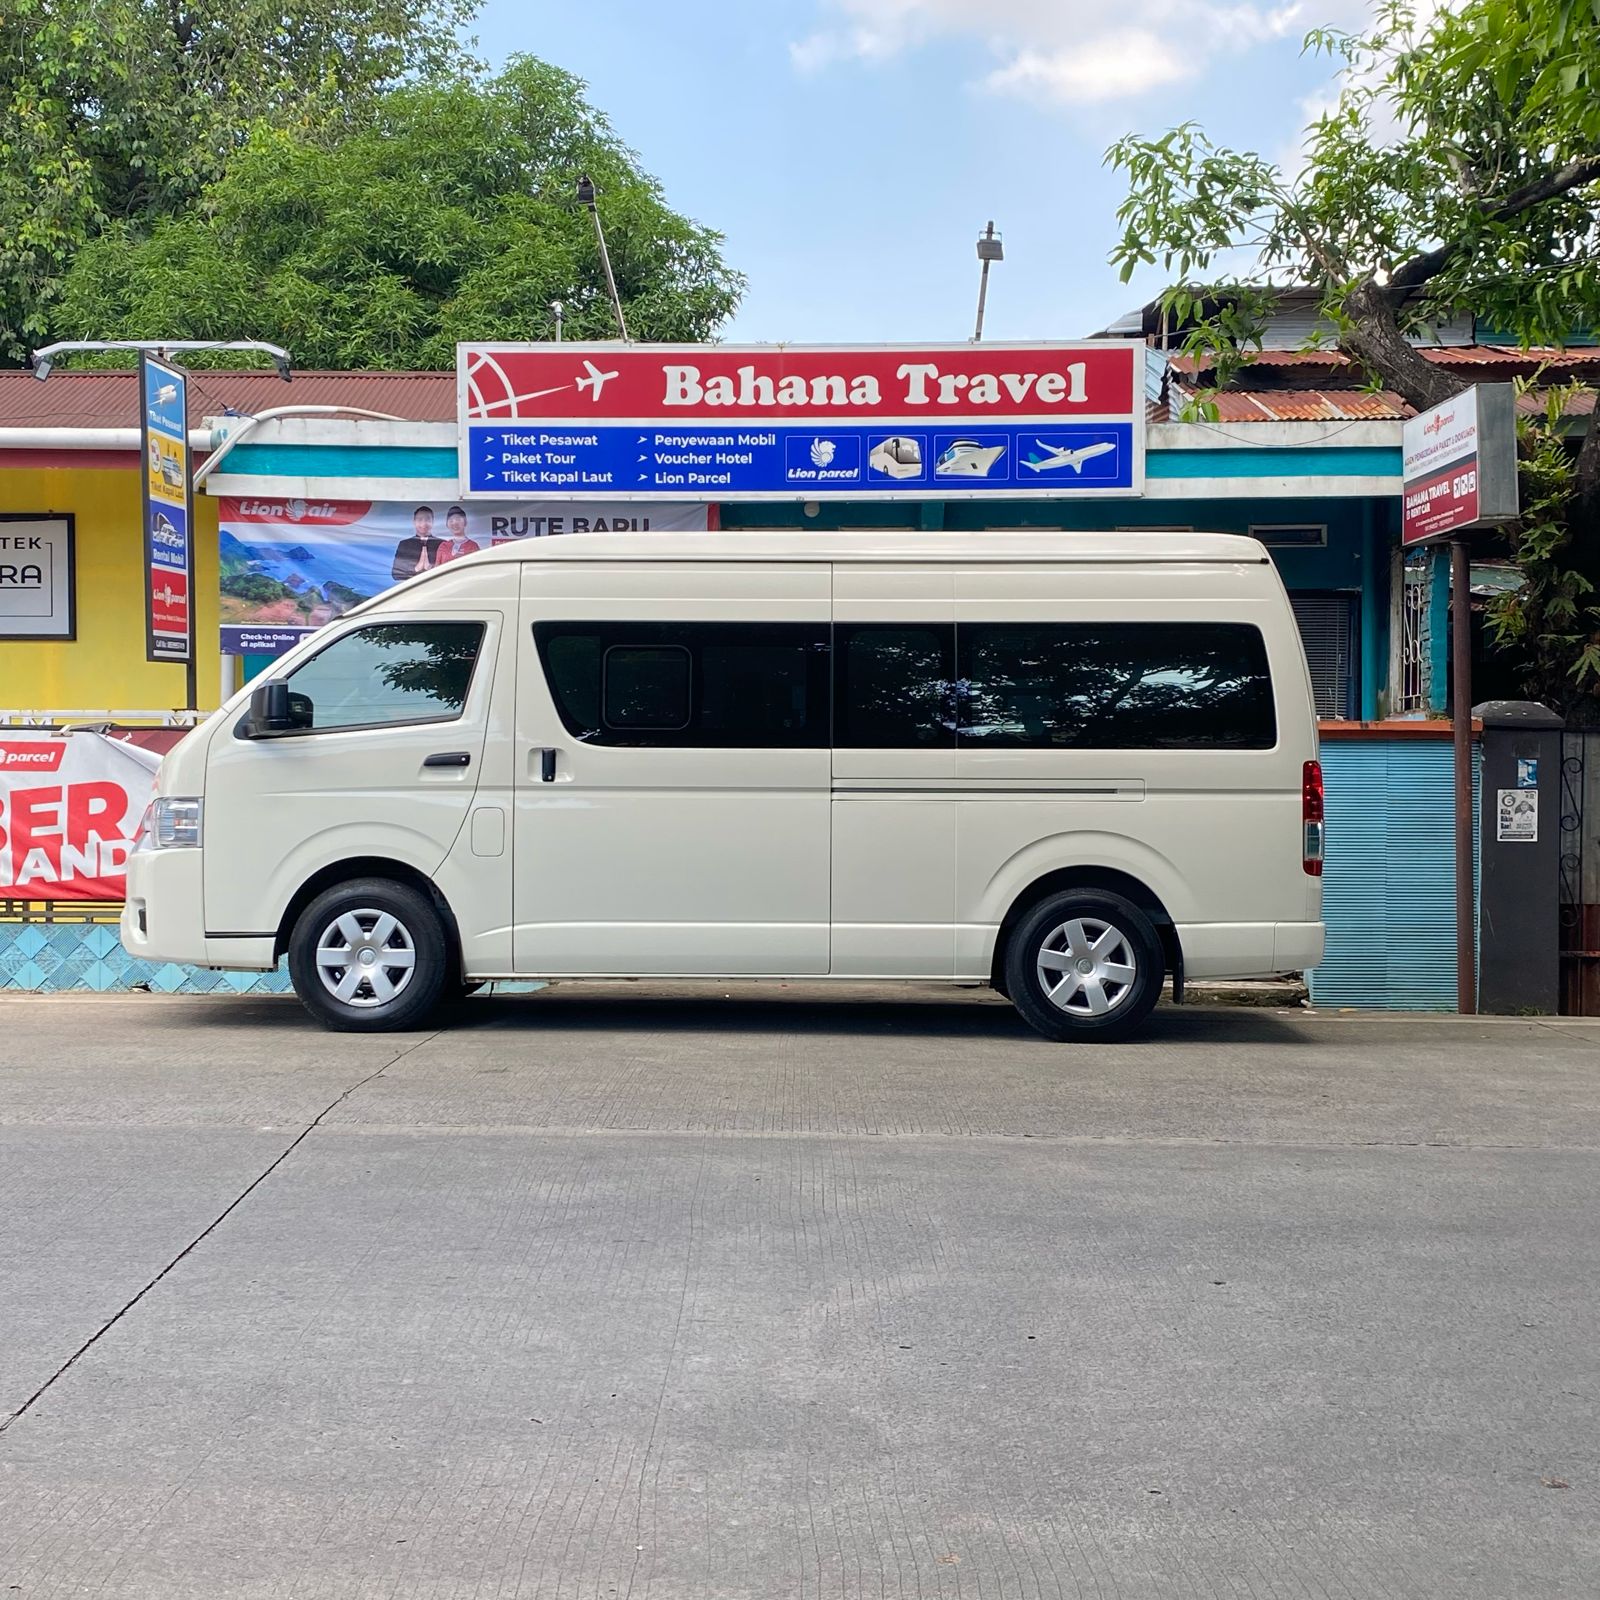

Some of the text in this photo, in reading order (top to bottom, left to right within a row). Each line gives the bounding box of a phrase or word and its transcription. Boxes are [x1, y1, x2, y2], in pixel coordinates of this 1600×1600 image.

[662, 362, 1089, 407] Bahana Travel
[501, 434, 598, 446] Tiket Pesawat
[655, 434, 776, 448] Penyewaan Mobil
[502, 452, 576, 464] Paket Tour
[655, 452, 752, 464] Voucher Hotel
[502, 471, 613, 485] Tiket Kapal Laut
[655, 472, 731, 484] Lion Parcel
[788, 467, 859, 480] Lion parcel
[240, 501, 337, 517] Lion air
[491, 517, 564, 537] RUTE
[240, 633, 271, 641] Check-in
[249, 641, 276, 649] aplikasi
[6, 751, 55, 763] parcel
